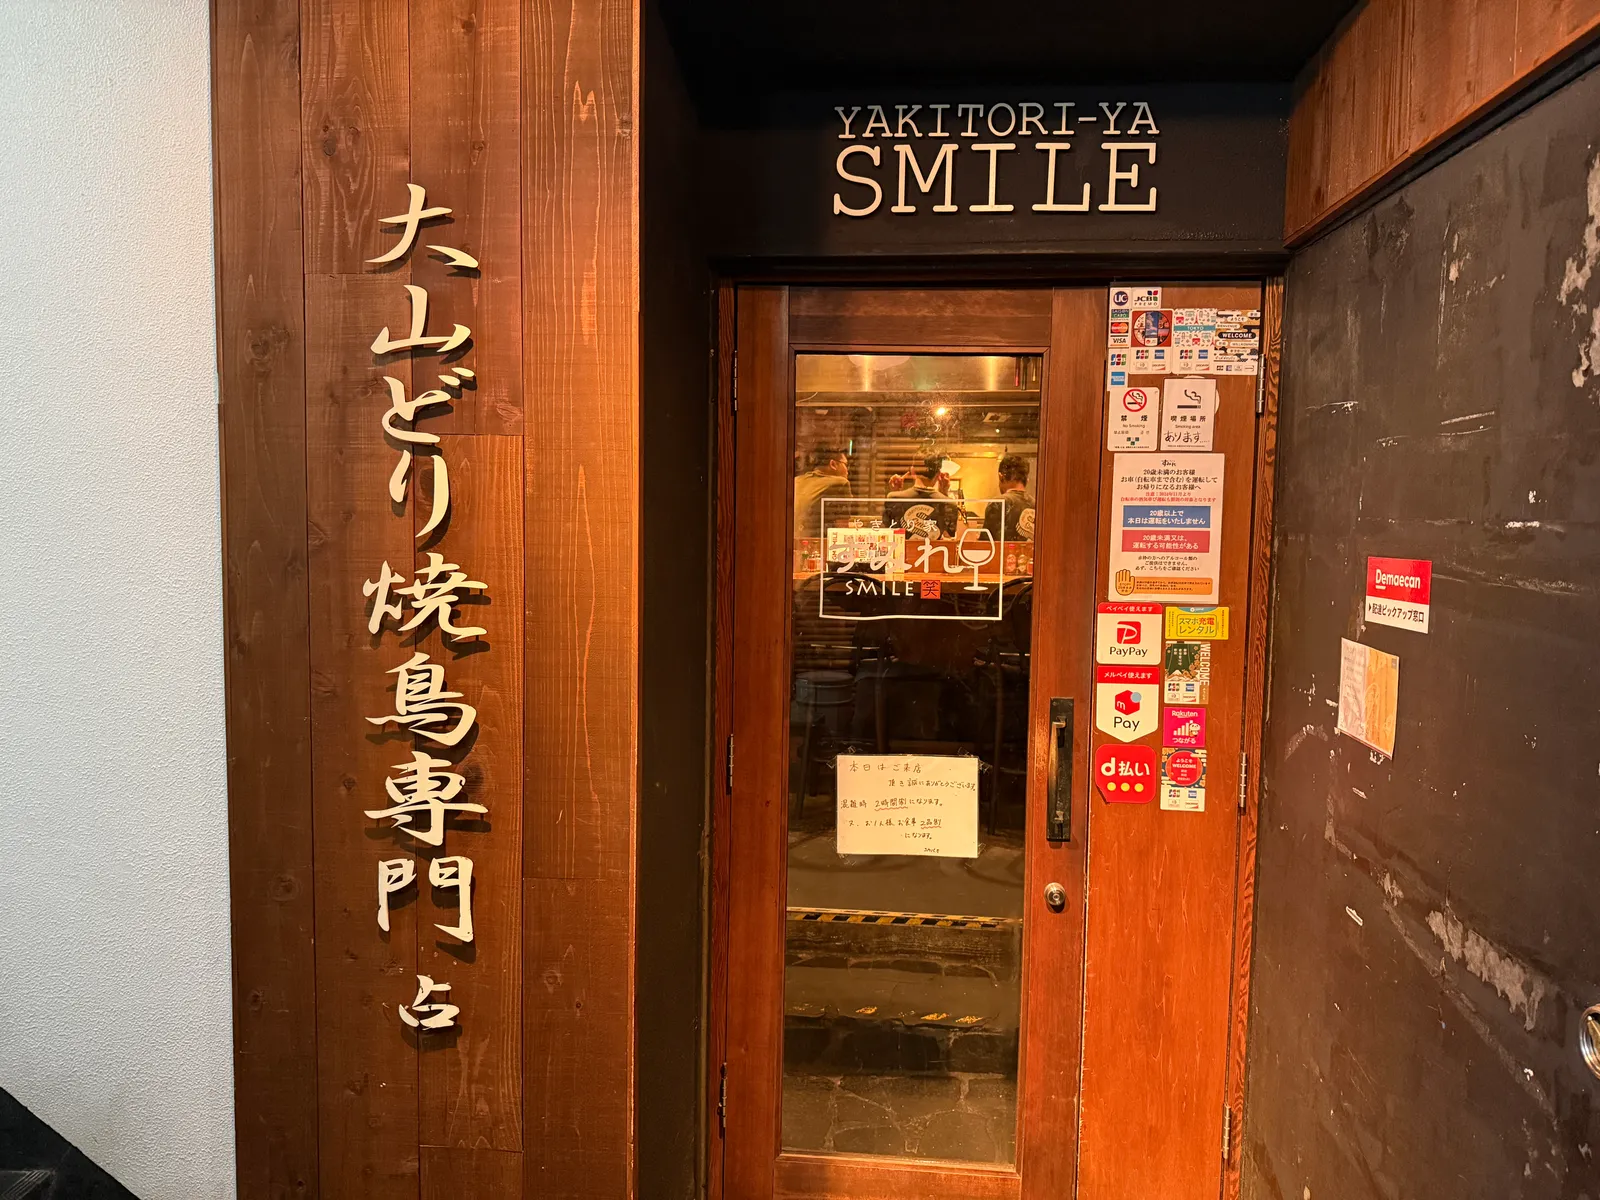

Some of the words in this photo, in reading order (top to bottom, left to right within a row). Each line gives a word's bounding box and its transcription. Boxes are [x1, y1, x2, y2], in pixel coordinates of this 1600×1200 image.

[834, 102, 1160, 138] YAKITORI-YA
[833, 142, 1157, 217] SMILE
[1114, 294, 1128, 303] UC
[1163, 430, 1202, 444] あります
[852, 519, 938, 532] やきとり家
[1127, 517, 1206, 525] 本日は運転をいたしません
[829, 538, 965, 574] すみれ
[1375, 569, 1421, 589] Demaecan
[845, 580, 914, 596] SMILE
[922, 581, 939, 598] 笑
[1178, 617, 1215, 625] スマホ充電
[1372, 603, 1425, 623] 配達ピックアップ窓口
[1179, 625, 1215, 635] レンタル
[1109, 646, 1148, 657] PayPay
[1200, 643, 1211, 686] WELCOME
[1104, 671, 1153, 679] メルペイ使えます
[1171, 710, 1199, 718] Rakuten
[1113, 716, 1140, 732] Pay
[1100, 756, 1150, 777] d払い
